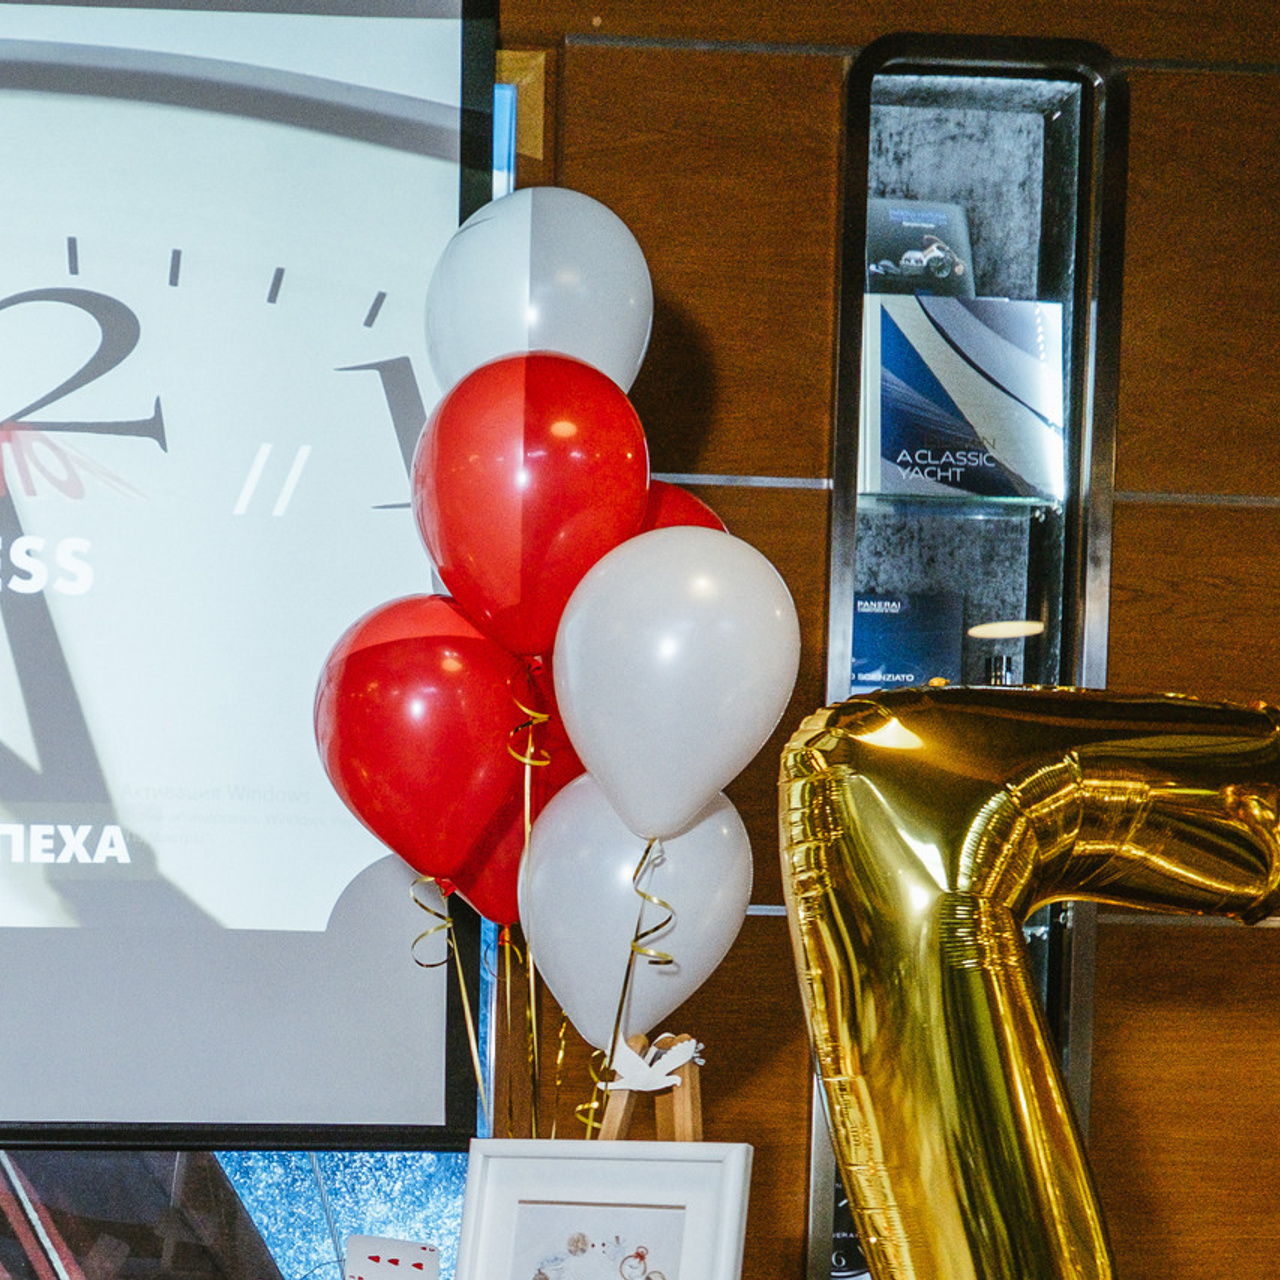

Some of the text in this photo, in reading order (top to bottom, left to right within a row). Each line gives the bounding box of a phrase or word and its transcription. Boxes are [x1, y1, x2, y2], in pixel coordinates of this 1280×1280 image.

[897, 448, 996, 468] A CLASSIC
[897, 466, 966, 482] YACHT
